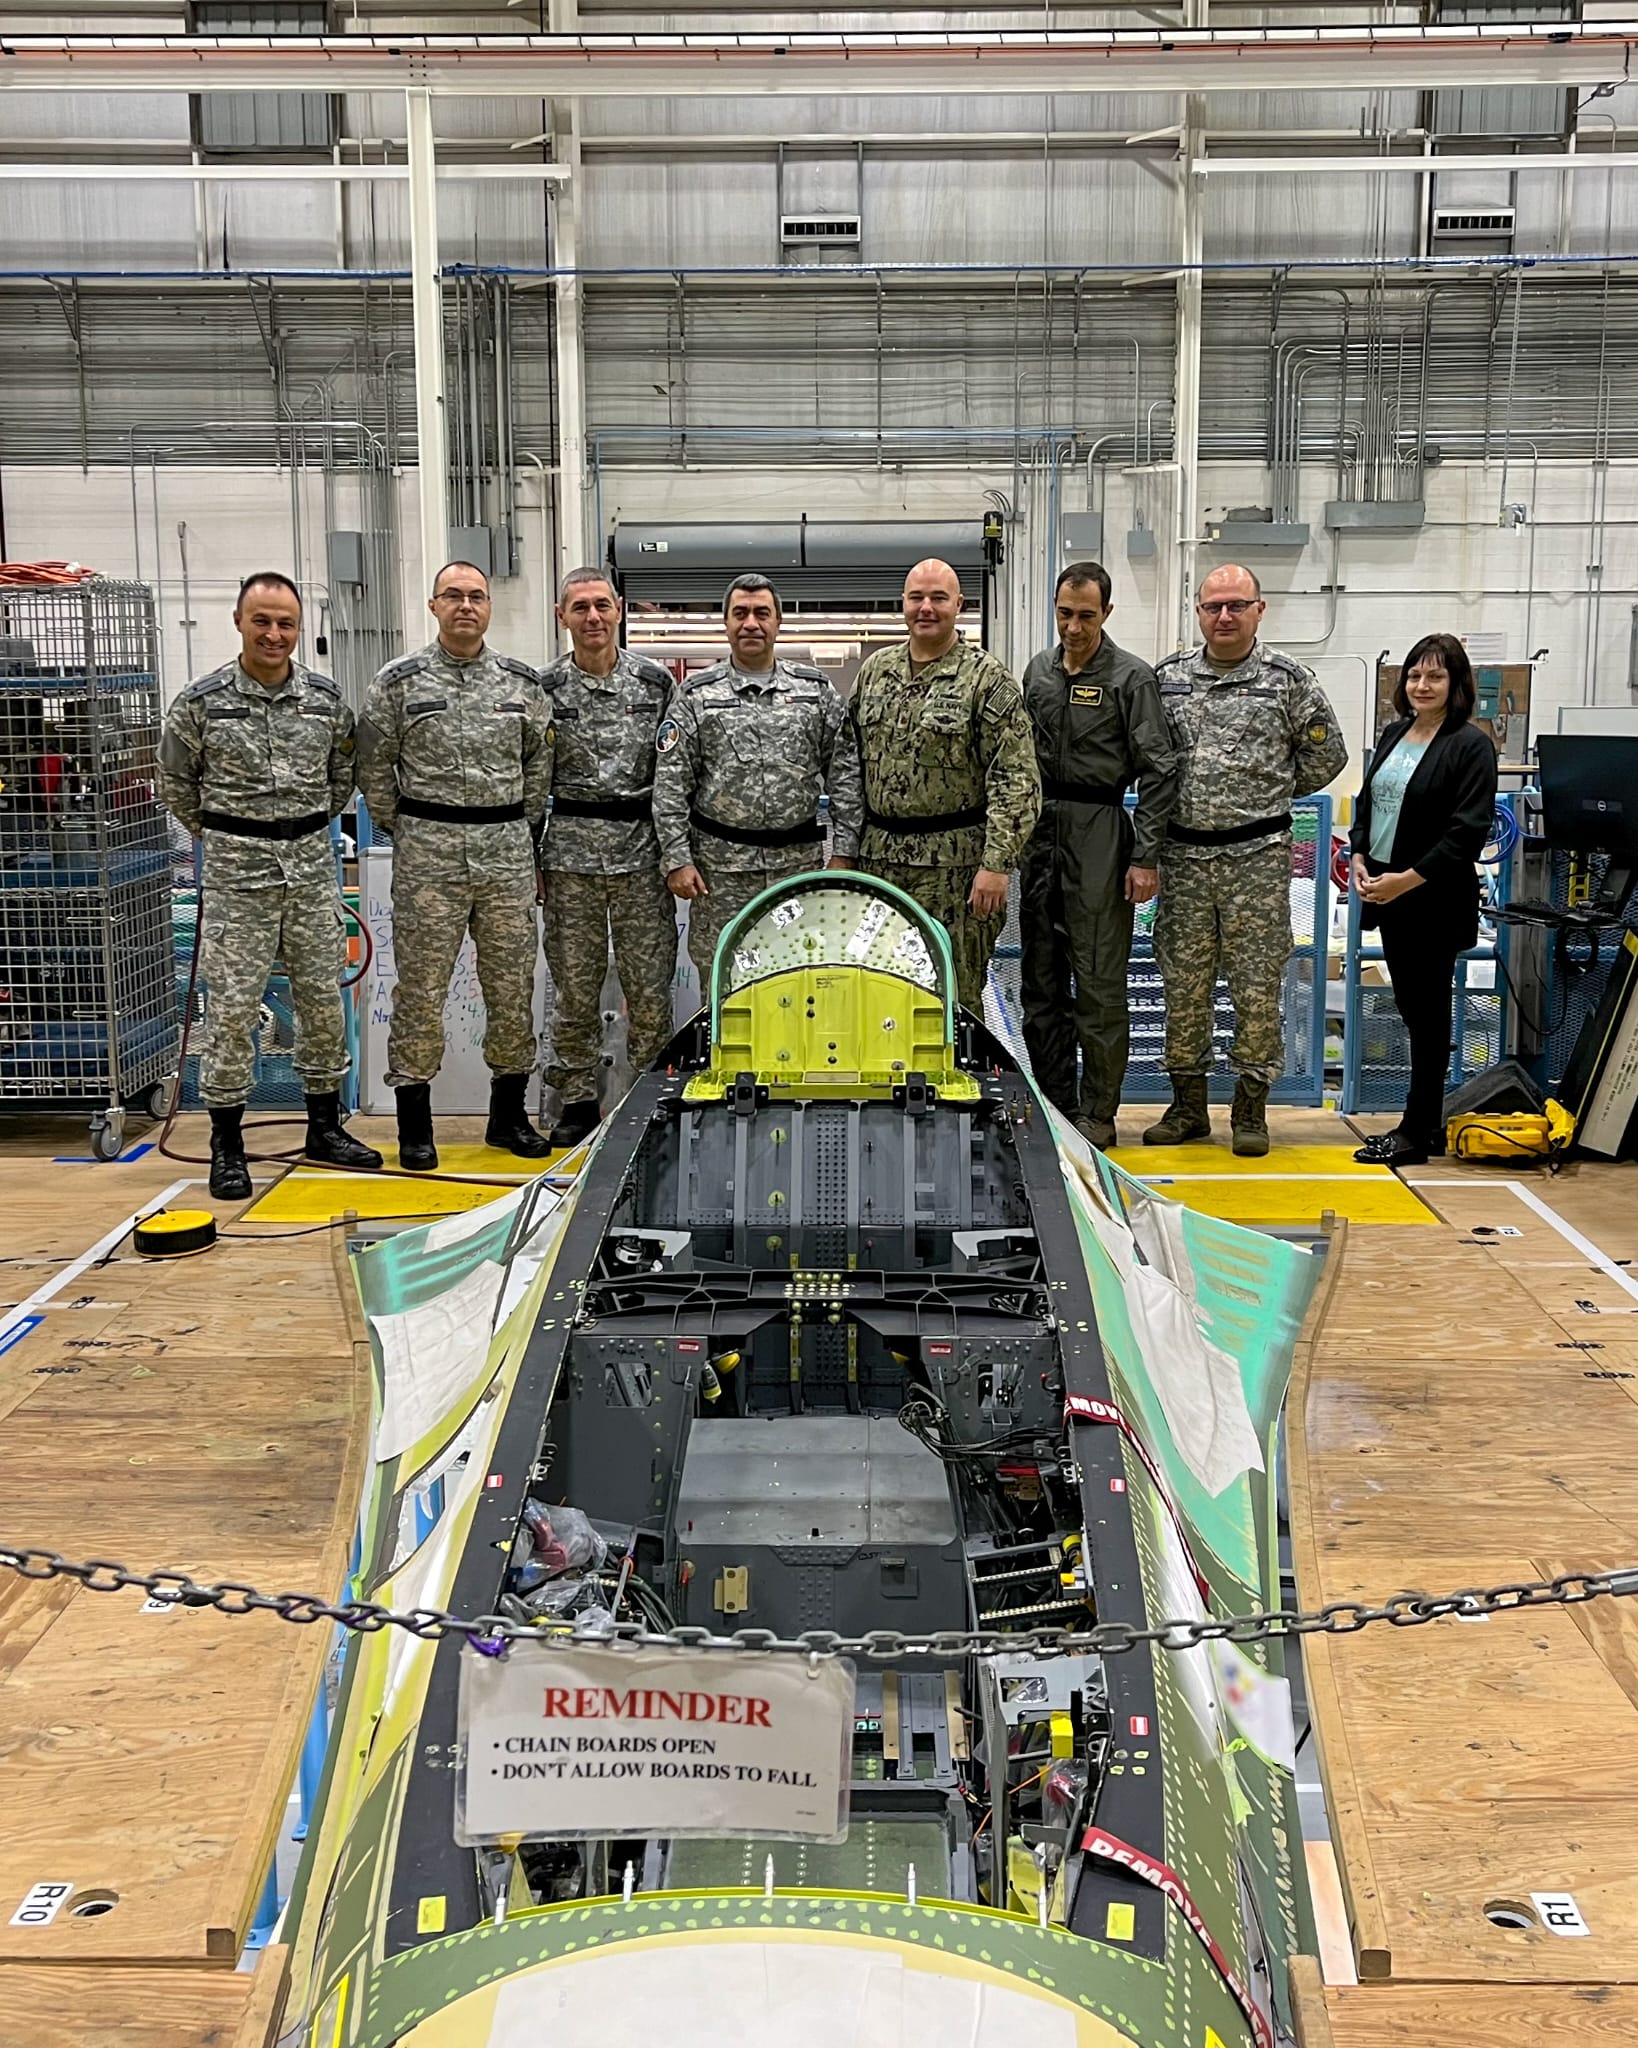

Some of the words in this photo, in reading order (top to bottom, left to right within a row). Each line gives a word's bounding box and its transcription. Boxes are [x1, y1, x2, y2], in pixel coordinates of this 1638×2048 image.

[543, 1687, 772, 1727] REMINDER
[505, 1737, 571, 1753] CHAIN
[577, 1737, 657, 1753] BOARDS
[662, 1738, 716, 1754] OPEN
[503, 1762, 567, 1779] DON'T
[570, 1762, 645, 1779] ALLOW
[651, 1762, 730, 1780] BOARDS
[735, 1766, 762, 1782] TO
[767, 1769, 817, 1788] FALL
[19, 1885, 68, 1922] R10
[1541, 1902, 1580, 1926] R1
